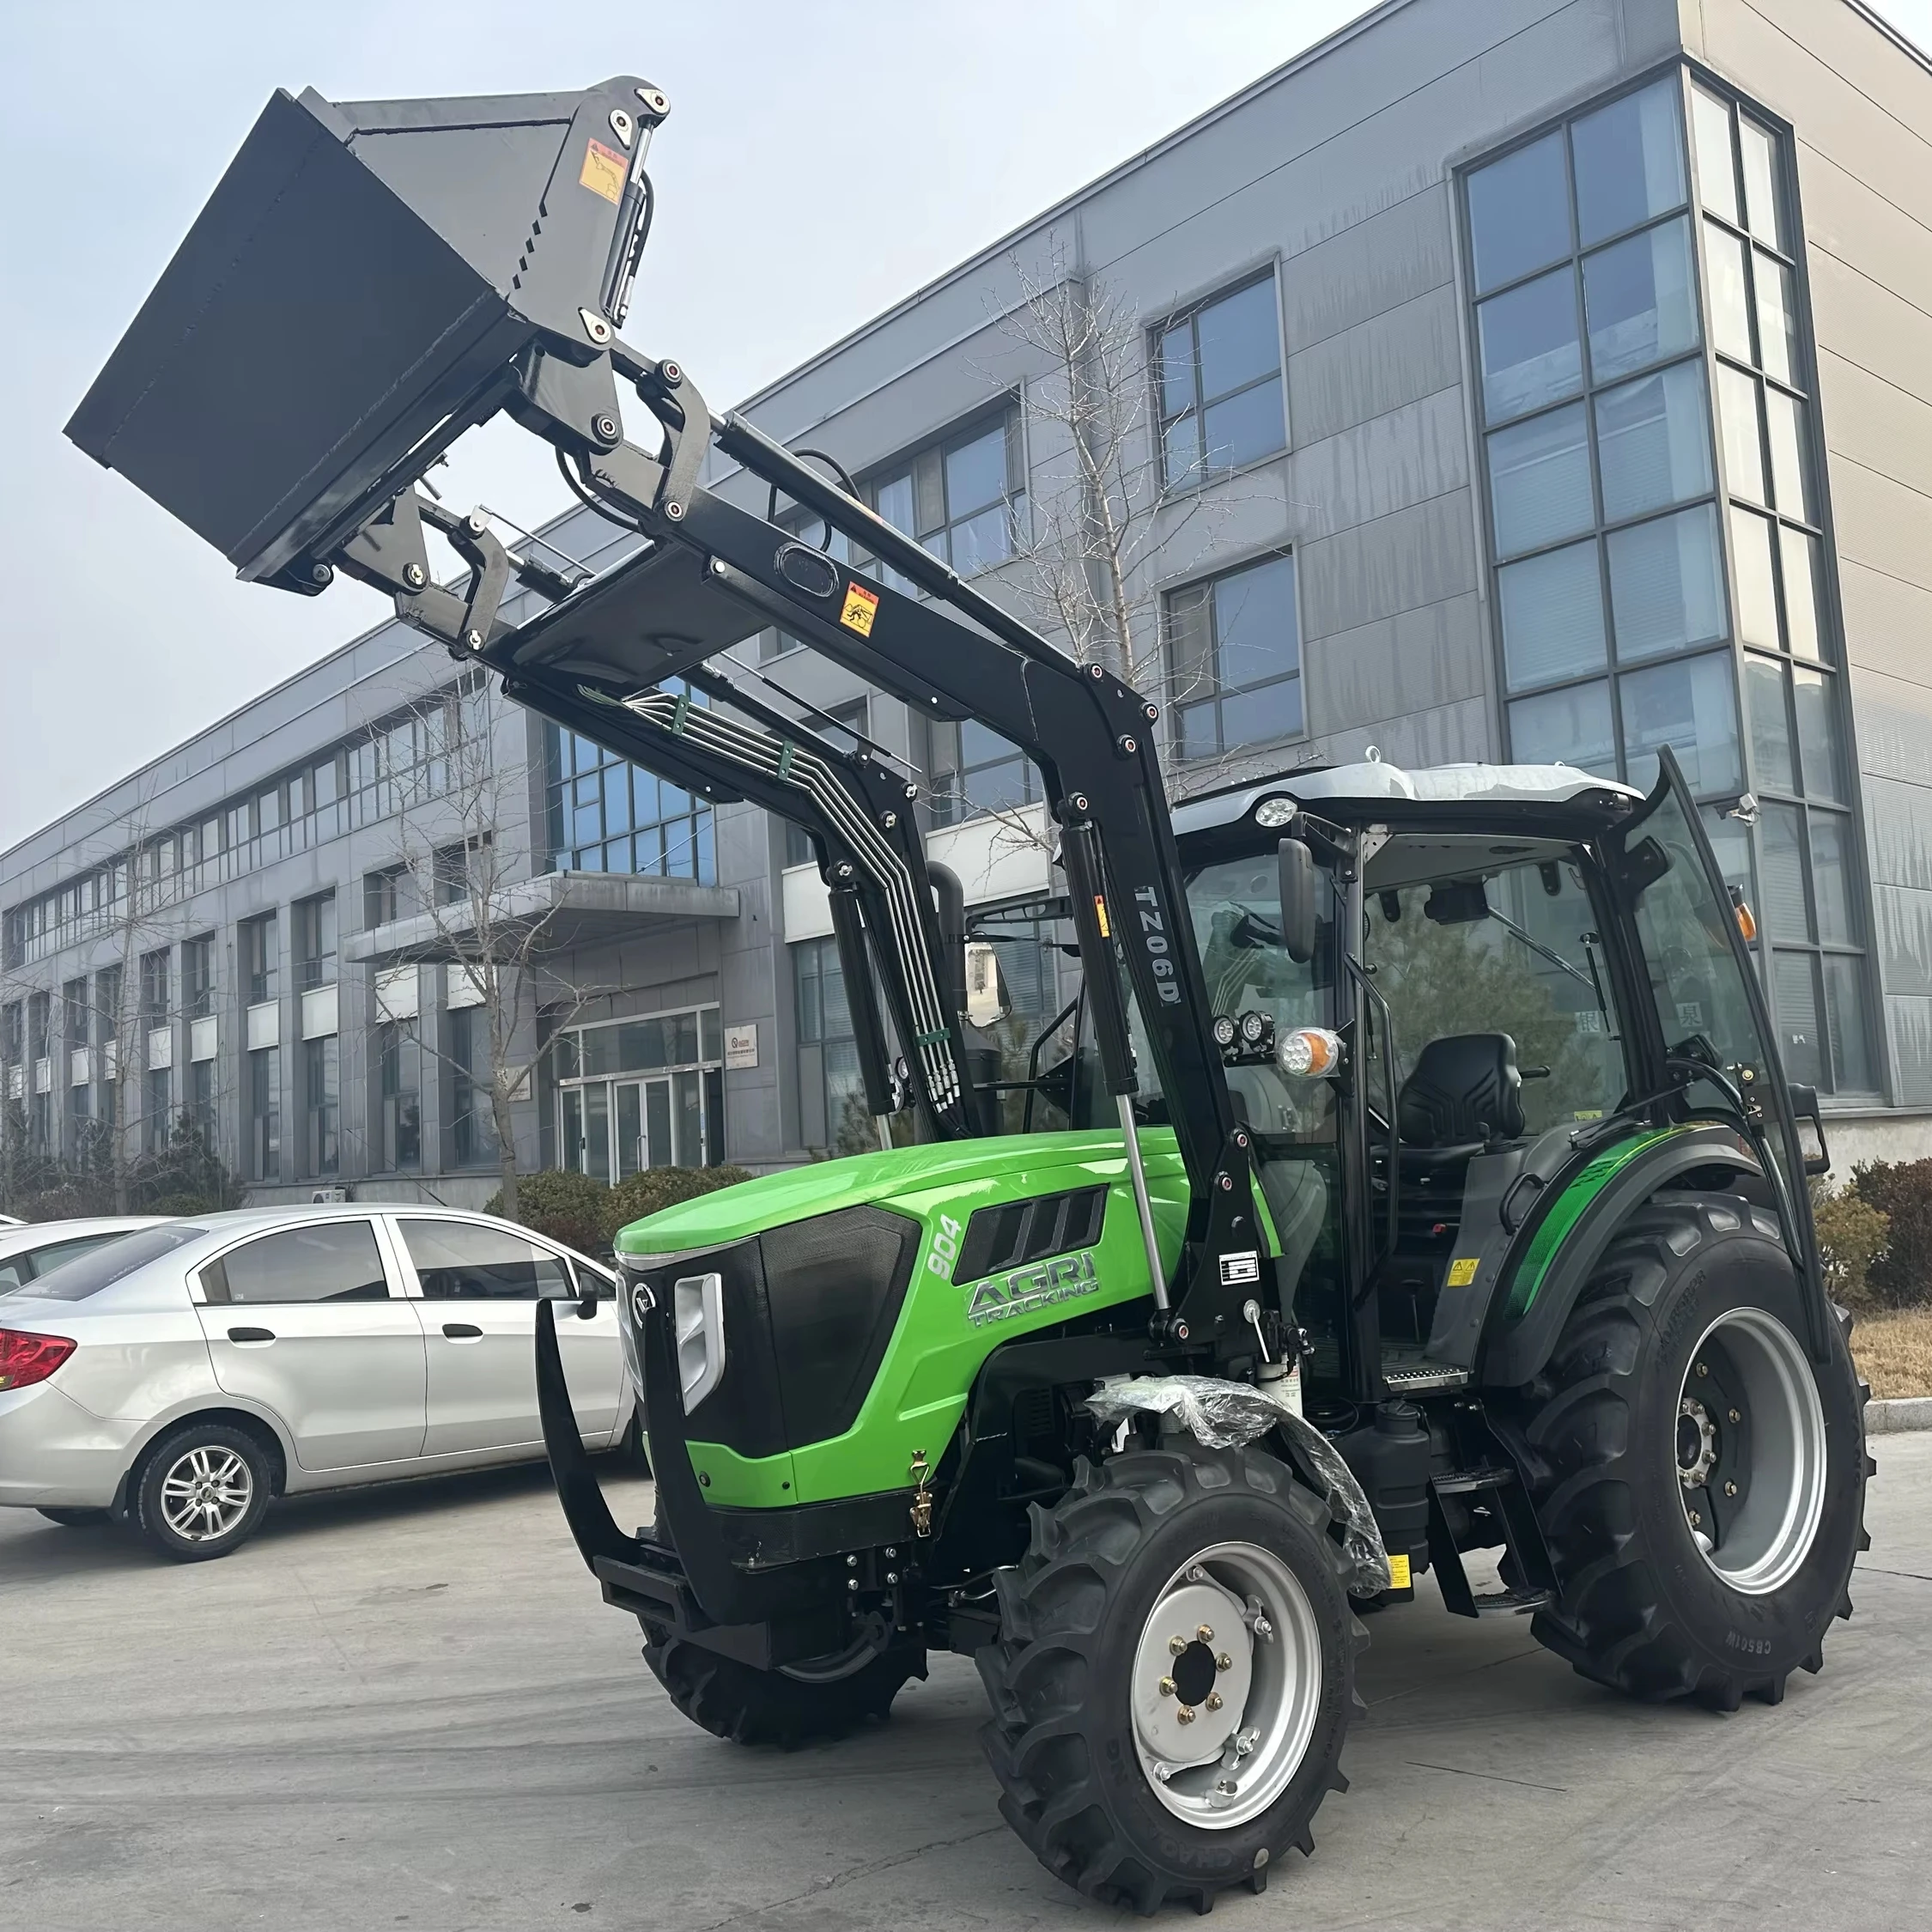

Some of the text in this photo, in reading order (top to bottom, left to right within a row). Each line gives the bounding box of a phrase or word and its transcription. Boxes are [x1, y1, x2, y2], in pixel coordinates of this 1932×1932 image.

[1134, 886, 1181, 1003] TZ06D
[927, 1213, 962, 1280] 904
[968, 1251, 1097, 1315] AGRI
[968, 1278, 1099, 1328] TRACKING
